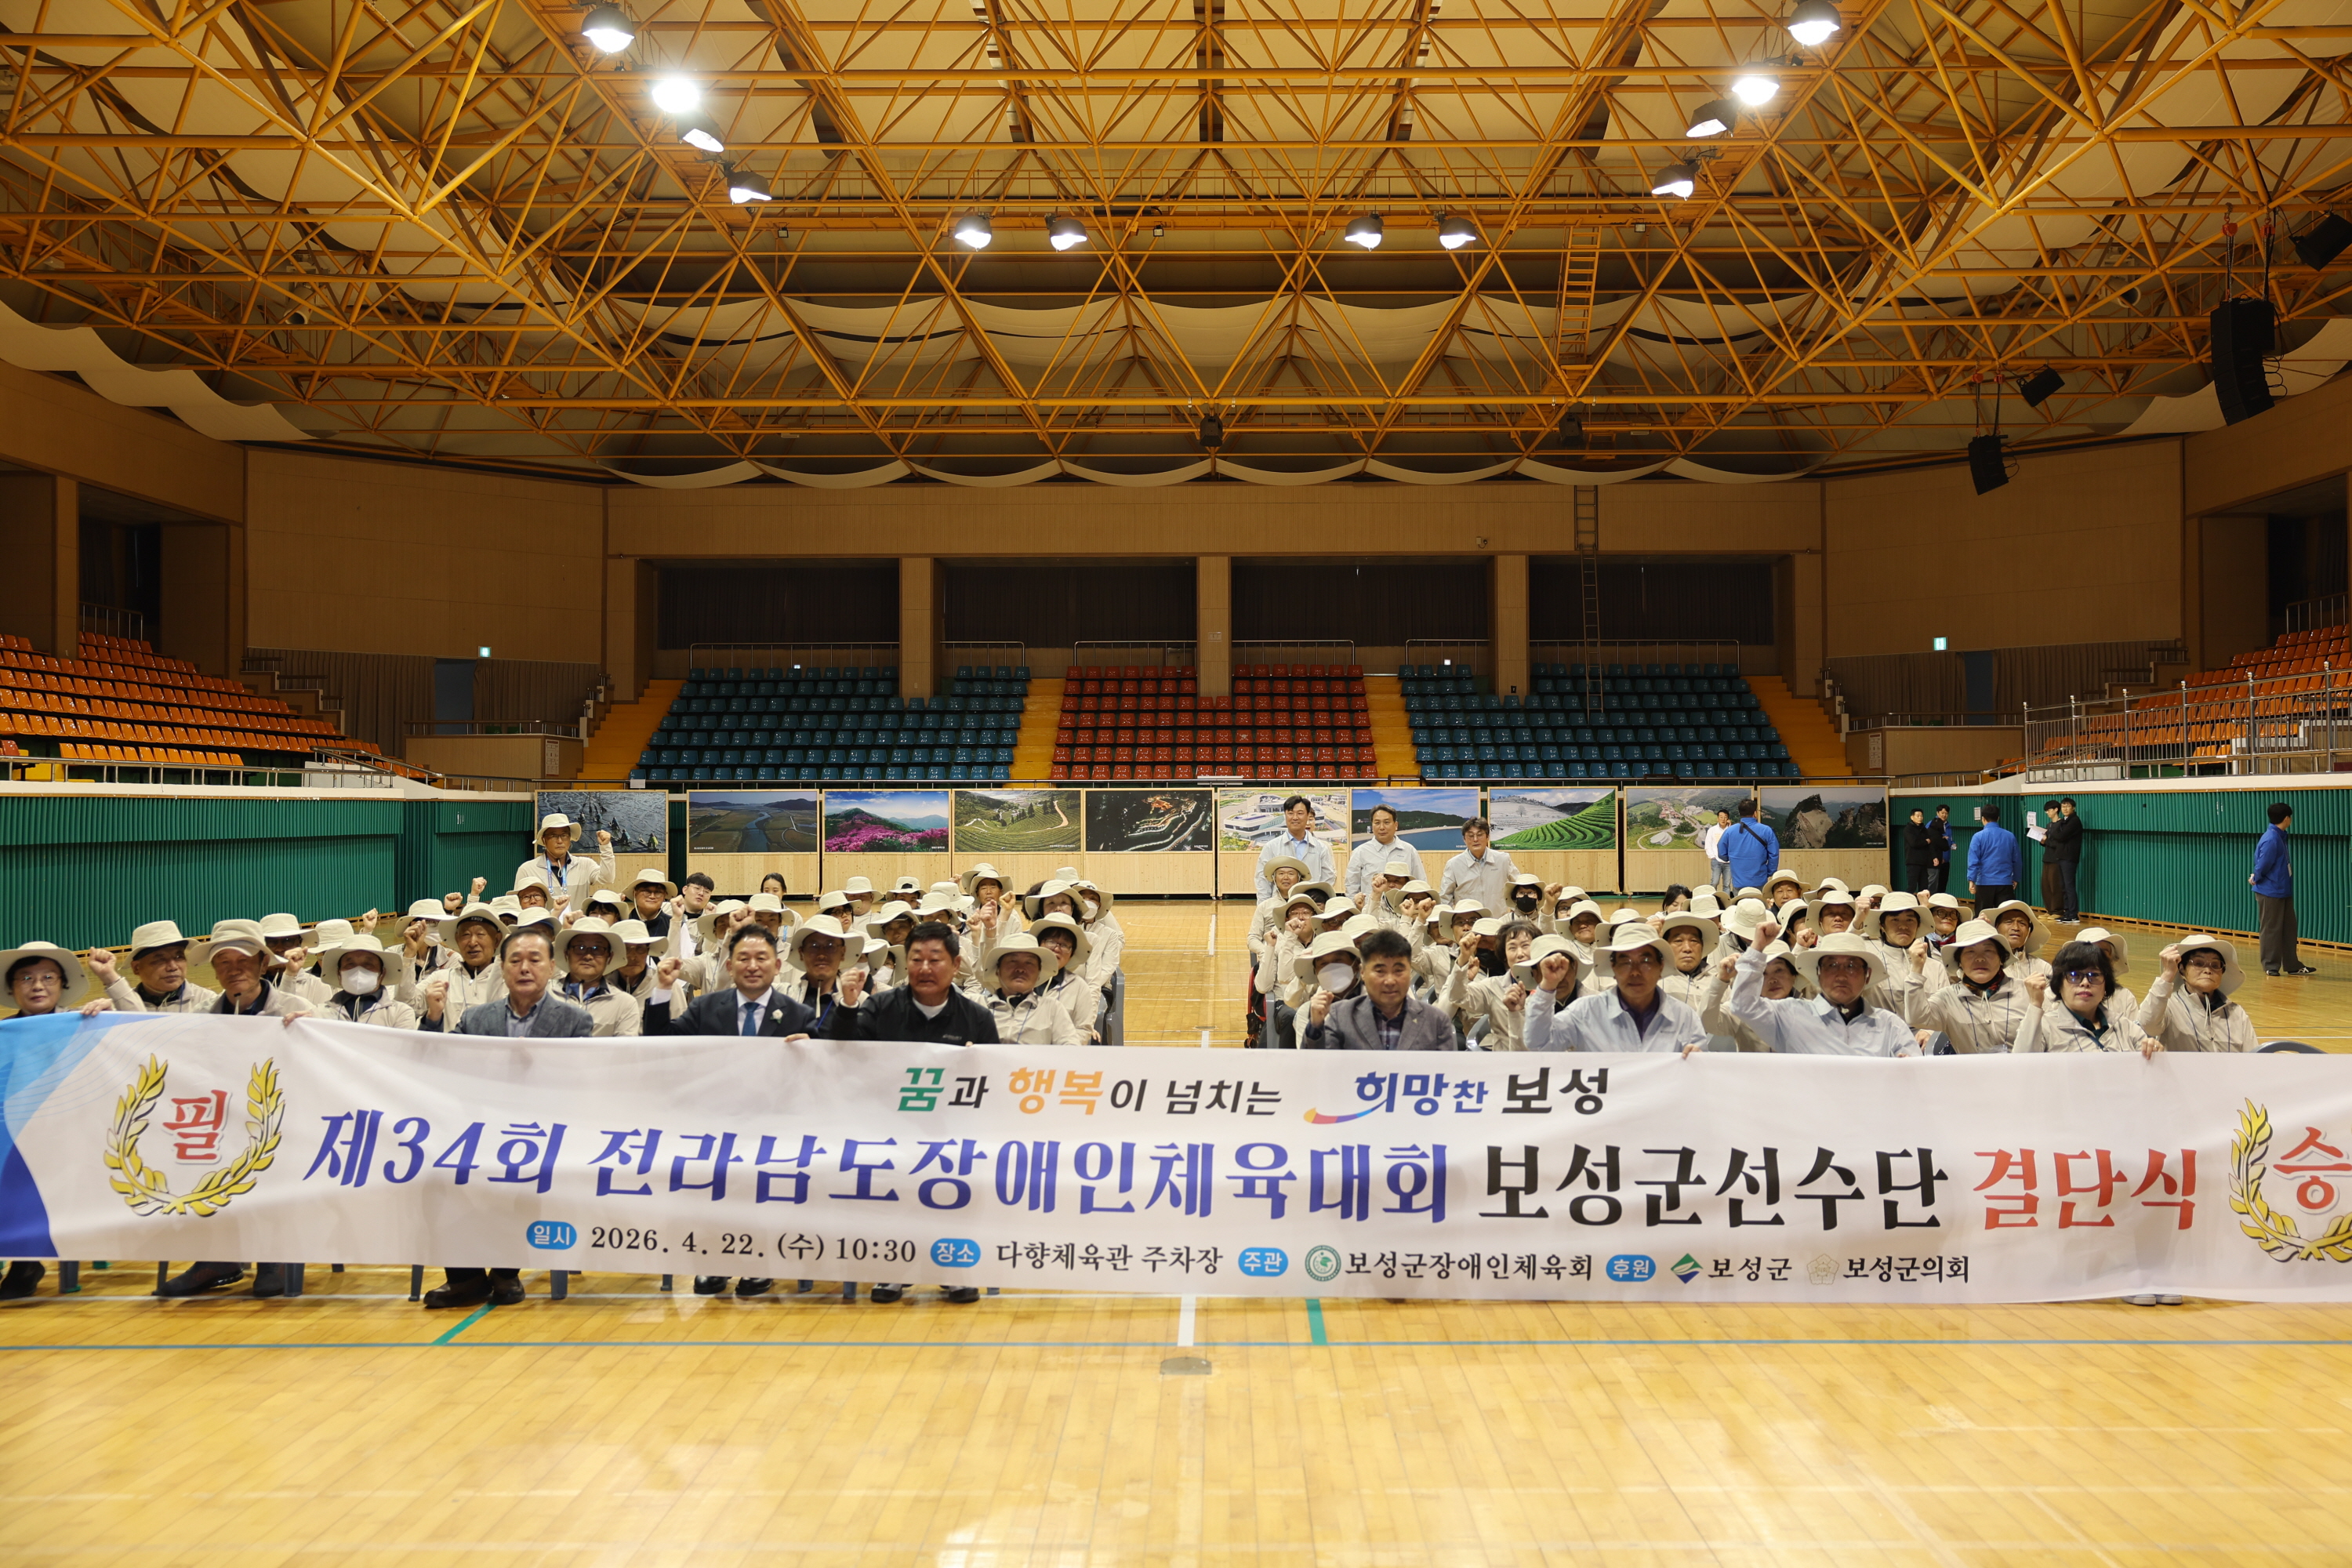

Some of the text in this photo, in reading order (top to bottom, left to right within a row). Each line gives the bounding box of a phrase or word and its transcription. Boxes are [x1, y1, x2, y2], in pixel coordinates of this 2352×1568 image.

[162, 1089, 227, 1160] 필
[896, 1066, 1610, 1121] 꿈과 행복이 넘치는 희망찬 보성
[302, 1109, 2197, 1231] 제34회 전라남도장애인체육대회 보성군선수단 결단식
[2272, 1127, 2352, 1210] 승
[533, 1225, 570, 1246] 일시
[590, 1226, 669, 1254] 2026.
[681, 1231, 708, 1255] 4.
[720, 1232, 764, 1258] 22.
[776, 1232, 825, 1261] (수)
[836, 1237, 916, 1263] 10:30
[936, 1243, 975, 1263] 장소
[995, 1240, 1134, 1272] 다향체육관
[1141, 1246, 1224, 1275] 주차장
[1243, 1251, 1283, 1272] 주관
[1344, 1250, 1592, 1282] 보성군장애인체육회
[1612, 1258, 1650, 1278] 후원
[1707, 1256, 1793, 1282] 보성군
[1842, 1255, 1969, 1283] 보성군의회
